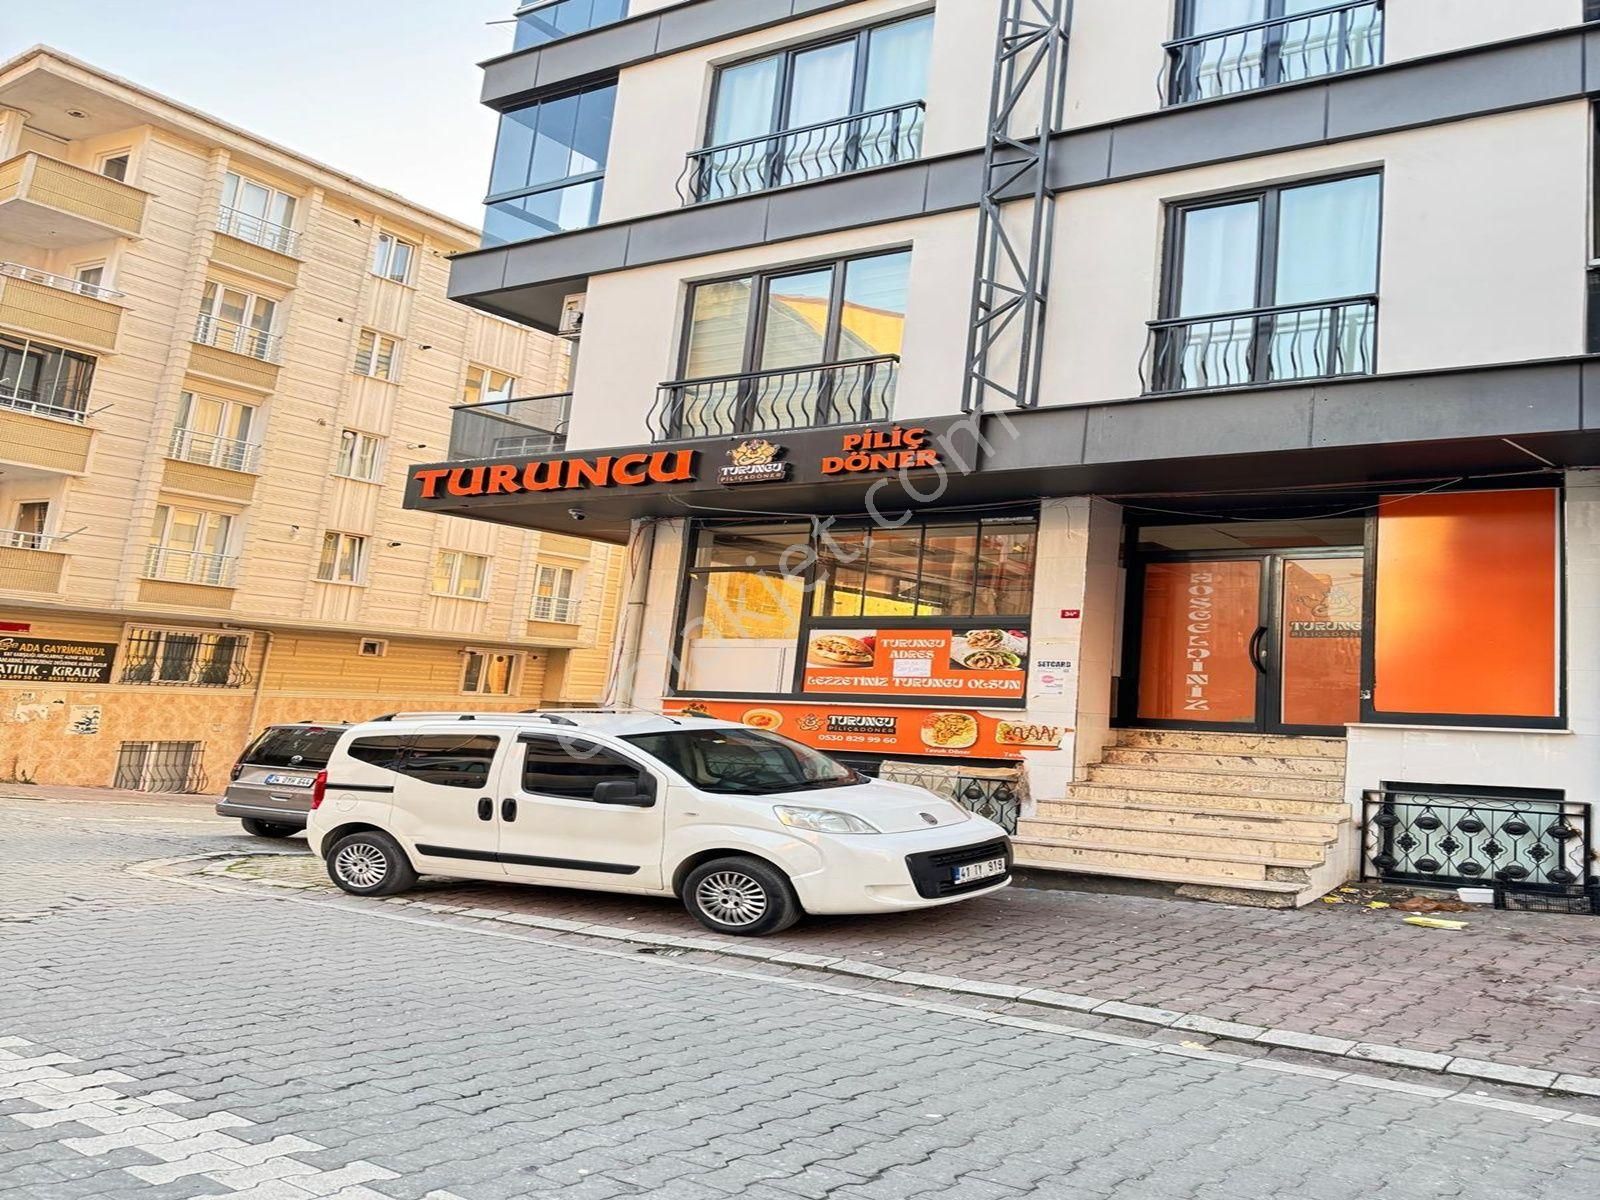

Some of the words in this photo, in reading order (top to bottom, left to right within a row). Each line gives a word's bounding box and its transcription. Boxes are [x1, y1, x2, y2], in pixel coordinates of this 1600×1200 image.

[842, 426, 926, 451] PİLİÇ
[821, 449, 939, 473] DÖNER
[414, 449, 694, 498] TURUNCU
[721, 463, 782, 475] TURUNCU
[1290, 621, 1361, 631] TURUNC
[880, 639, 946, 648] TURUNCU
[19, 643, 40, 653] ADA
[42, 644, 106, 656] GAYRİMENKUL
[889, 650, 935, 659] ADRES
[0, 664, 39, 675] ATILIK
[807, 676, 889, 687] LEZZETİNİZ
[893, 676, 963, 688] TURUNCU
[968, 679, 1021, 690] OLSUN
[829, 715, 895, 726] TURUNCU
[960, 867, 970, 878] 41
